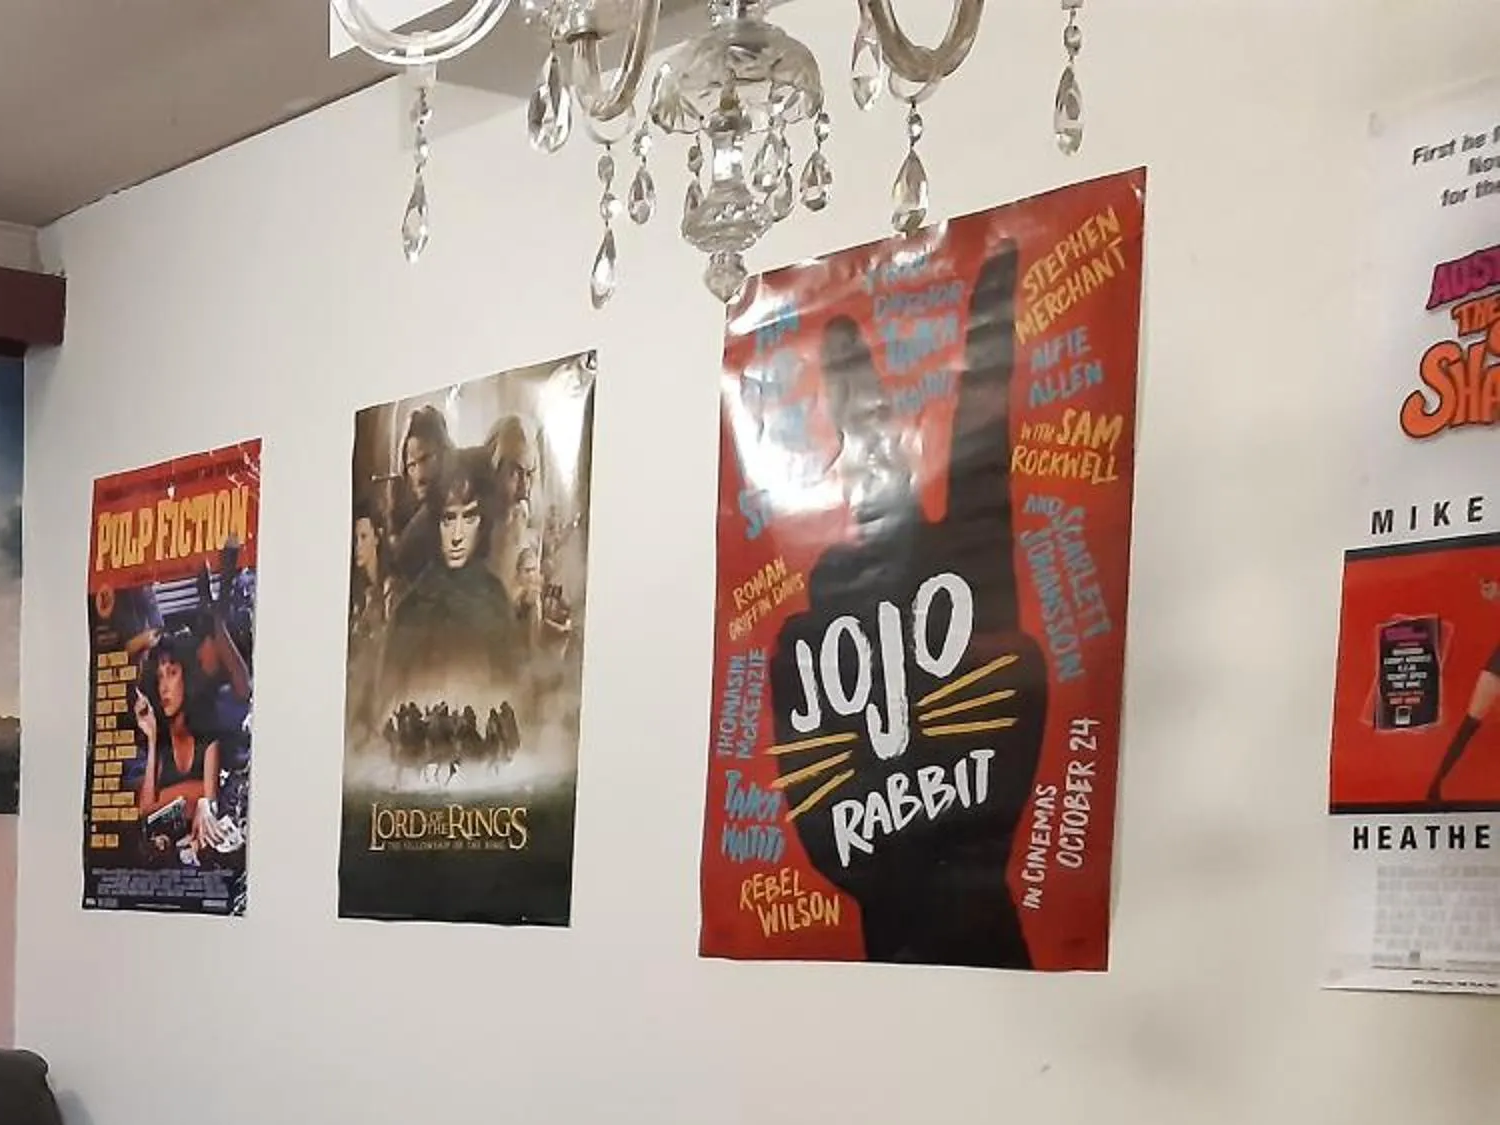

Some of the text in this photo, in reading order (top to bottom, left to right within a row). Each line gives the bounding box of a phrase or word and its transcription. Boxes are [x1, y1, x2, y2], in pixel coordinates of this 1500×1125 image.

[1412, 139, 1457, 166] First
[1461, 133, 1487, 152] be
[1441, 188, 1470, 207] for
[1022, 205, 1121, 303] STEPHEN
[1015, 235, 1126, 346] MERCHANT
[1030, 325, 1093, 375] ALFIE
[1029, 359, 1104, 410] ALLEN
[1057, 408, 1124, 451] SAM
[1011, 444, 1118, 485] ROCKWELL
[95, 484, 250, 572] PULP FICTION
[1023, 493, 1064, 517] AND
[1371, 496, 1484, 535] MIKE
[732, 555, 787, 612] ROMAN
[1051, 506, 1112, 640] SCARLETT
[728, 597, 773, 642] GRIFFIN
[791, 572, 974, 760] JOJO
[831, 748, 996, 868] RABBIT
[1055, 717, 1101, 869] OCTOBER 24
[368, 802, 528, 851] LORD OF THE RINGS
[1020, 783, 1058, 910] IN CINEMAS
[739, 866, 805, 912] REBEL
[756, 891, 841, 938] WILSON
